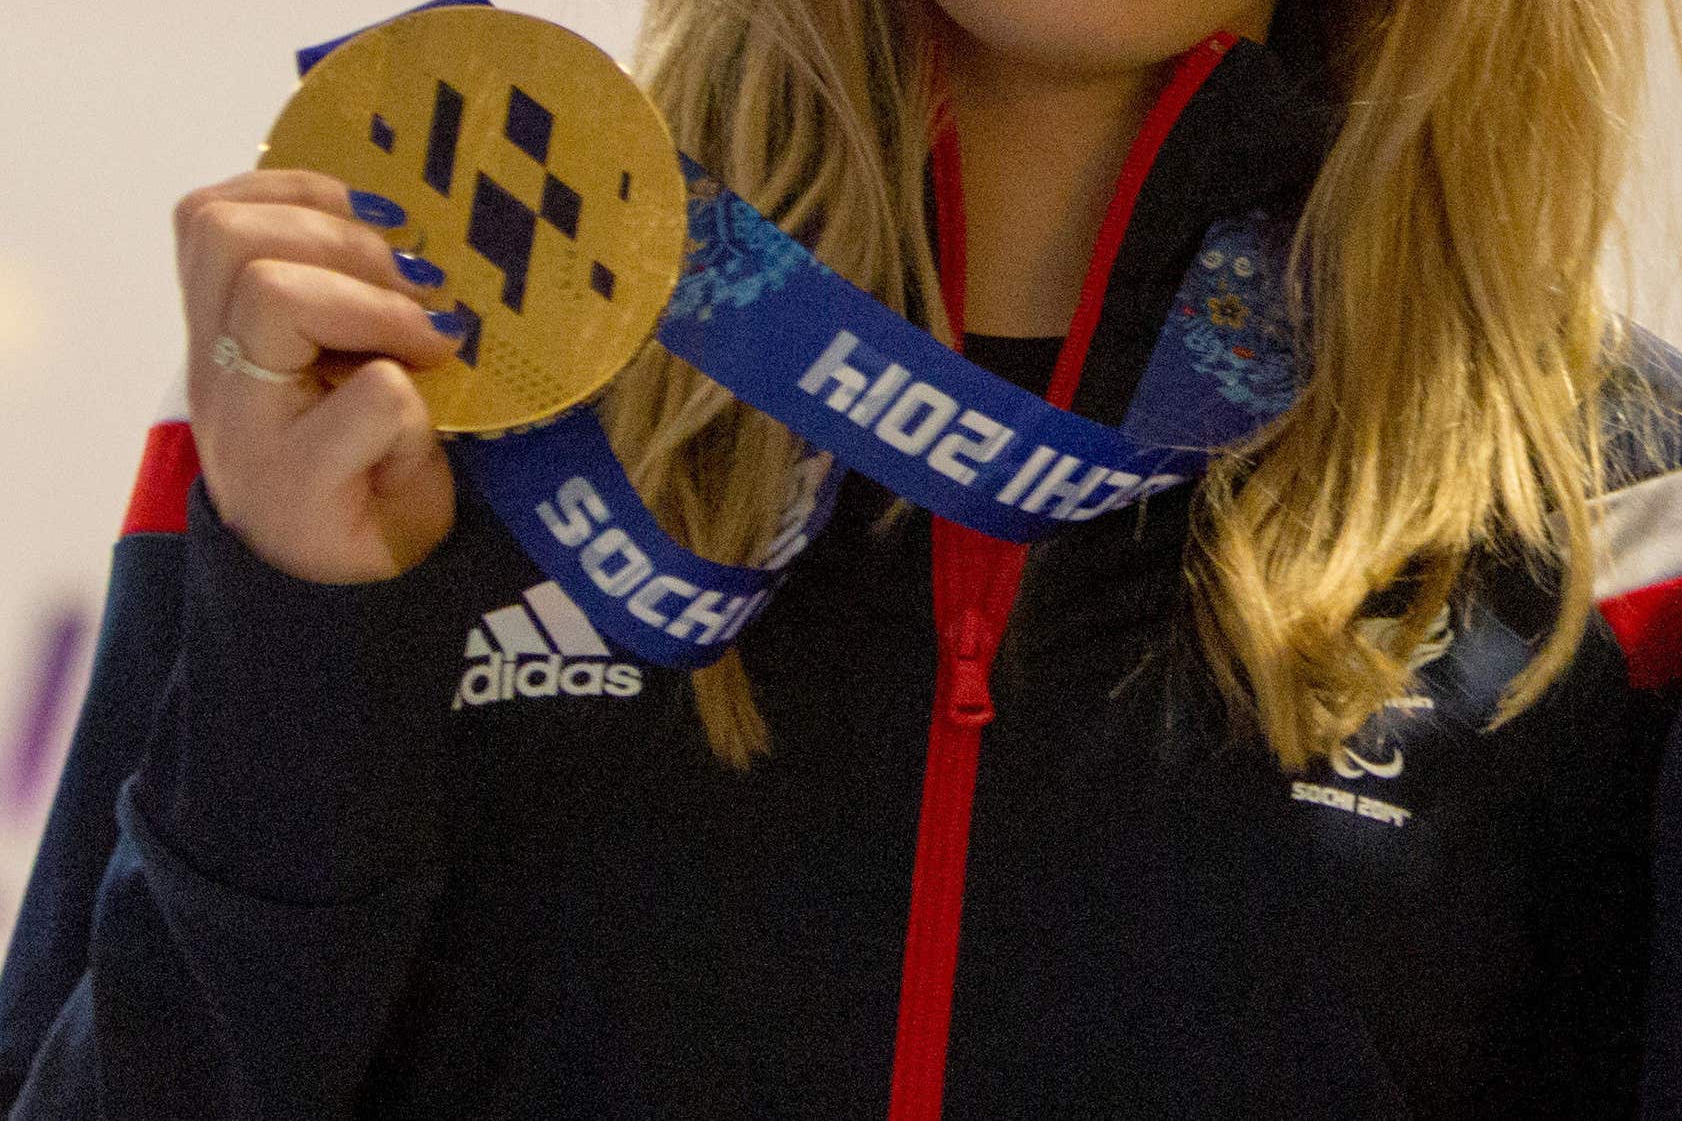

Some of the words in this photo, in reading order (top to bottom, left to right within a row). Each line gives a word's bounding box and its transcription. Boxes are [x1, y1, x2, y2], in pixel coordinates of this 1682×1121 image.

[799, 330, 1016, 486] 2014
[536, 476, 768, 646] SOCHI
[452, 650, 643, 711] didas
